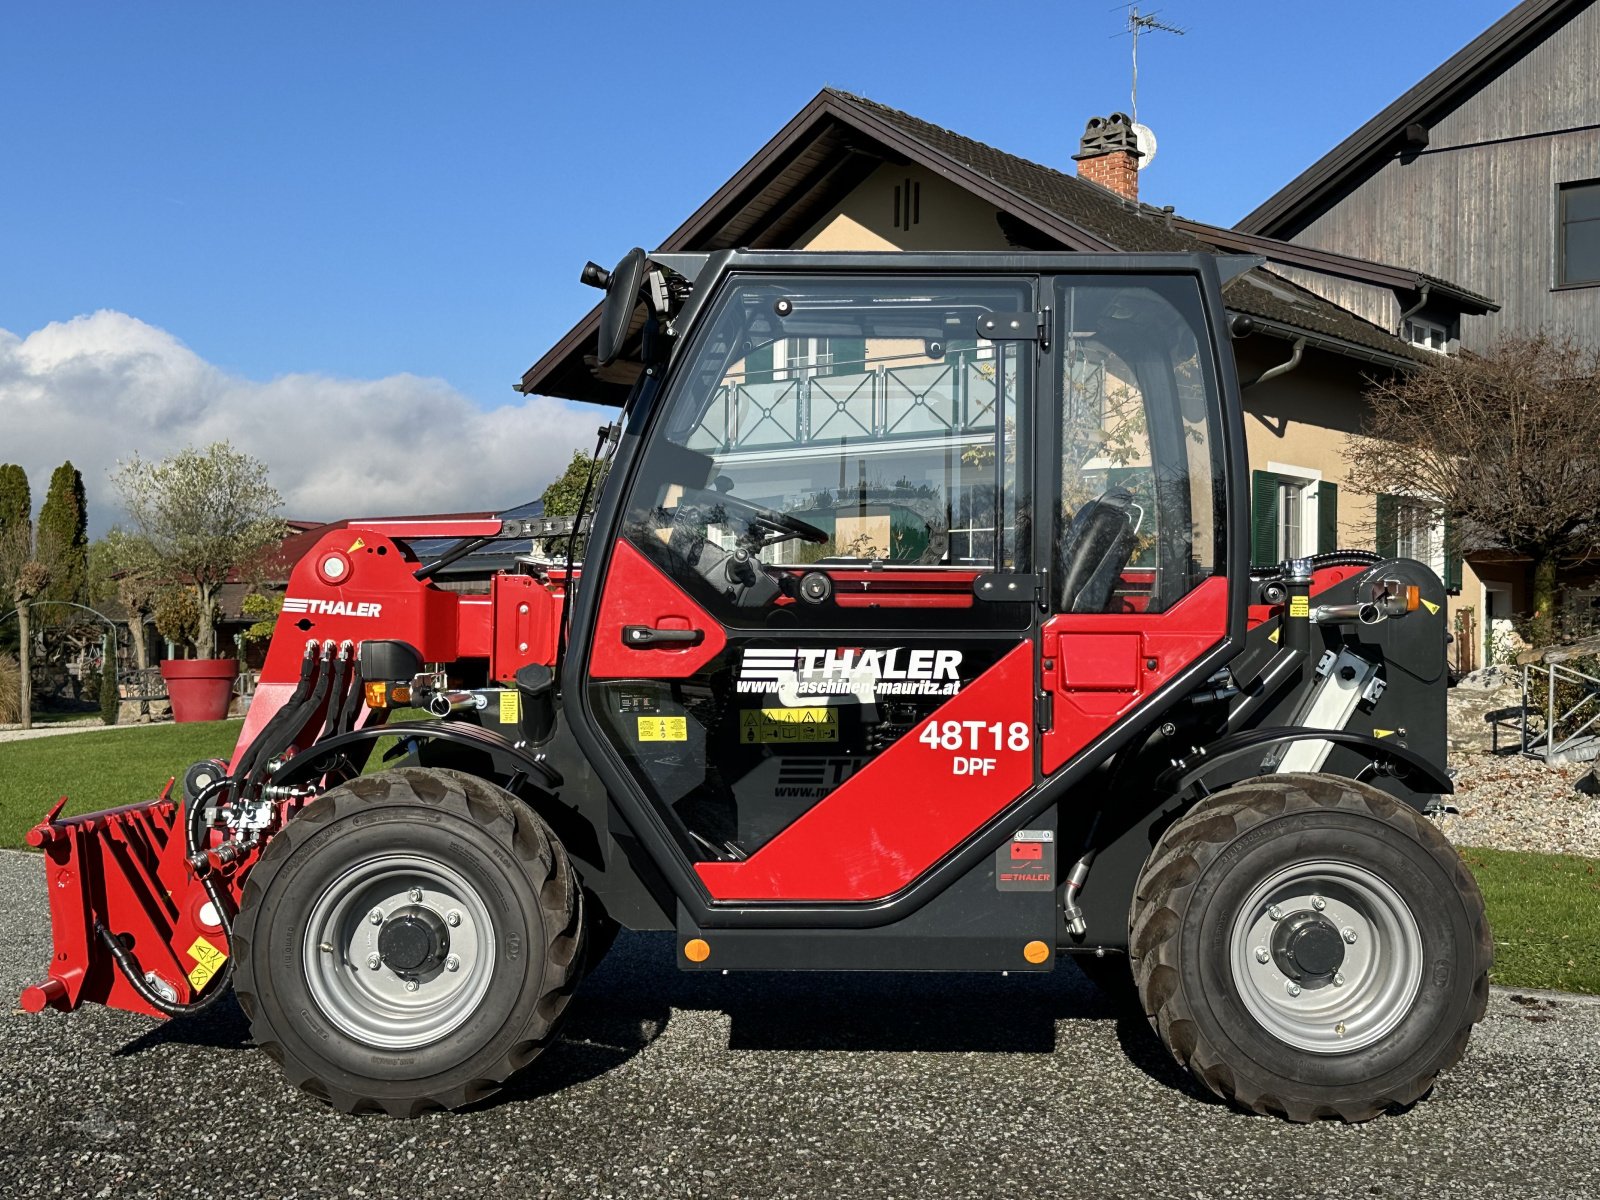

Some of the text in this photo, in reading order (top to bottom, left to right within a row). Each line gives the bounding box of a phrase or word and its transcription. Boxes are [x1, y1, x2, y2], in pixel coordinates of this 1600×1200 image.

[308, 599, 383, 618] THALER
[797, 648, 964, 680] THALER
[736, 681, 960, 696] wwwaschinen-mauritz.at
[919, 720, 1031, 752] 48T18
[952, 756, 997, 777] DPF
